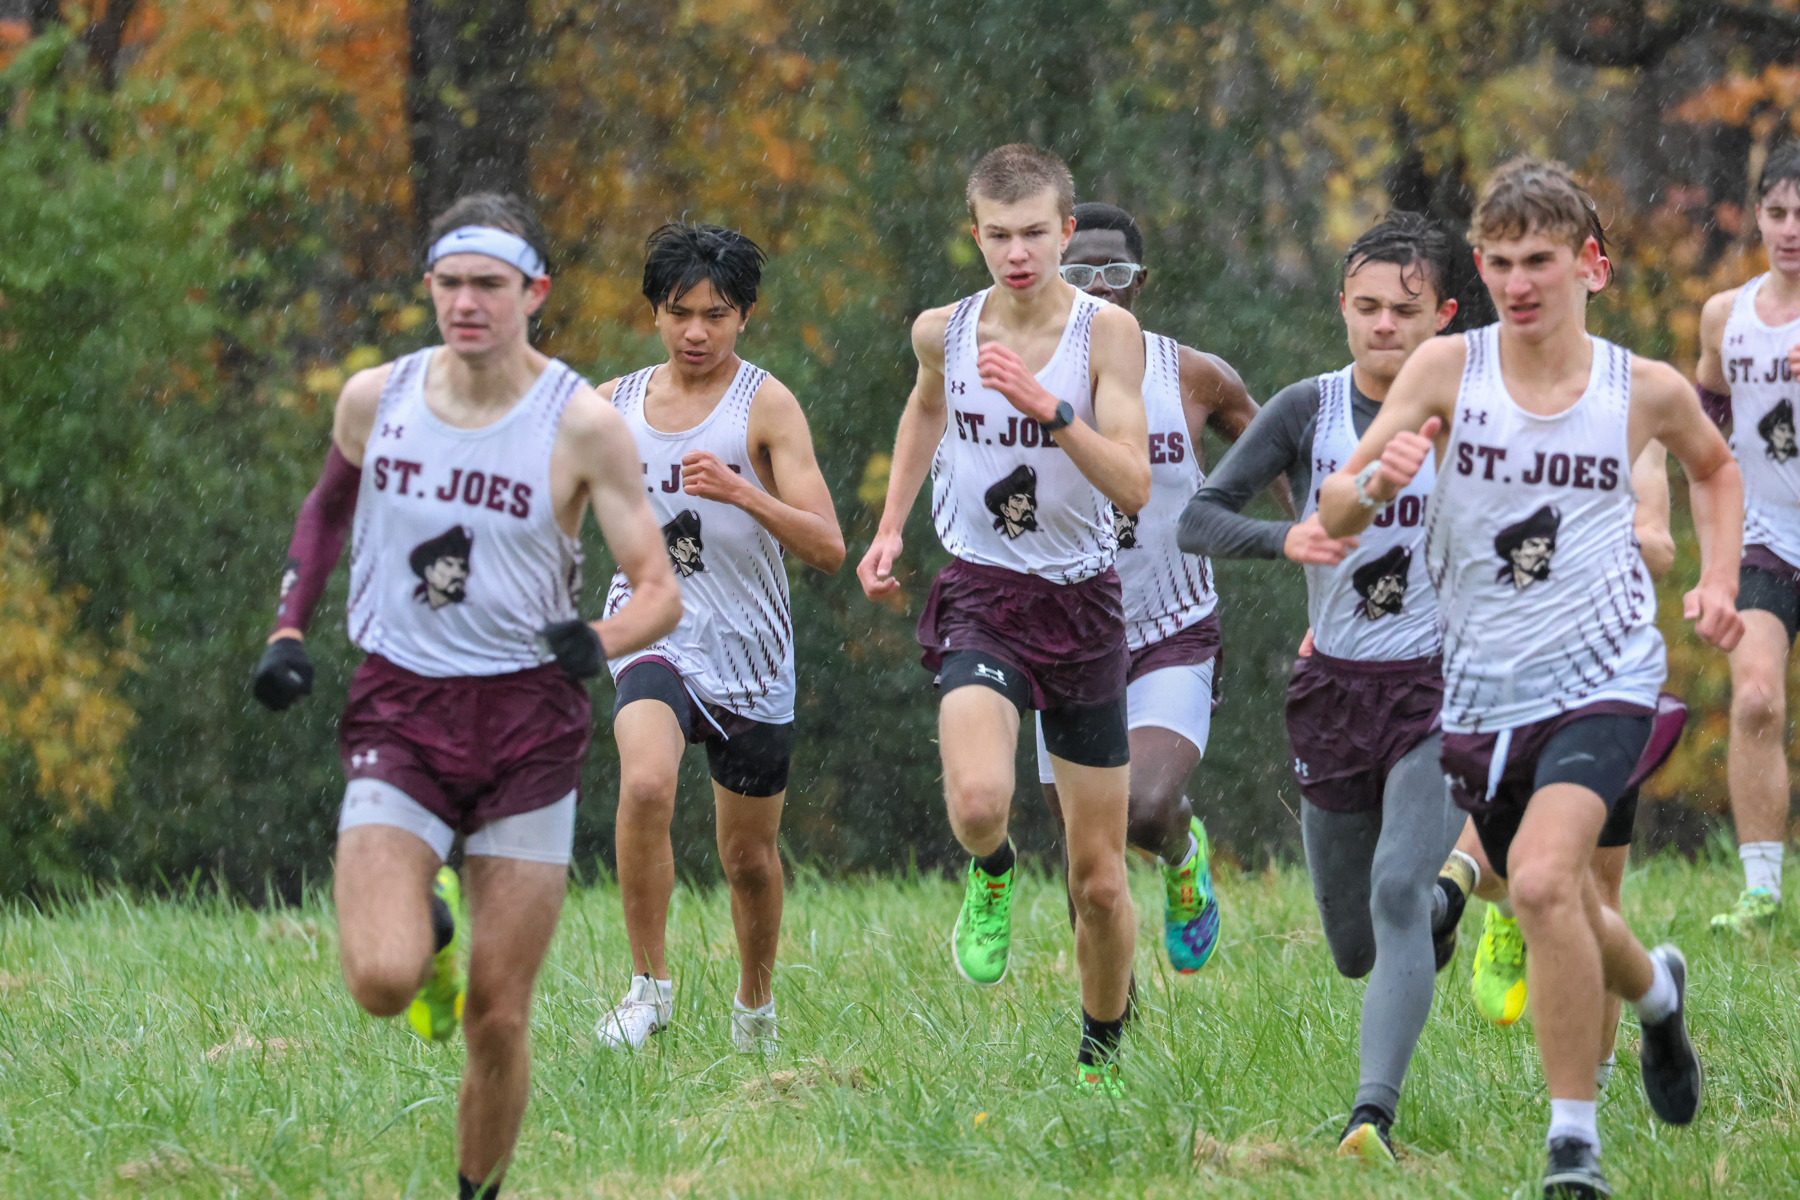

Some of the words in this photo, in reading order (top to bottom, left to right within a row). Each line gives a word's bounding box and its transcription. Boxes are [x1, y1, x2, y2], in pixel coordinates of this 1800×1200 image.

[1728, 357, 1758, 383] ST.
[1764, 357, 1792, 383] JO
[955, 409, 992, 445] ST.
[998, 416, 1060, 448] JO
[1148, 431, 1184, 464] ES
[1457, 442, 1511, 483] ST.
[1522, 452, 1619, 491] JOES
[374, 456, 425, 498] ST.
[436, 468, 532, 519] JOES
[1373, 494, 1428, 527] JO
